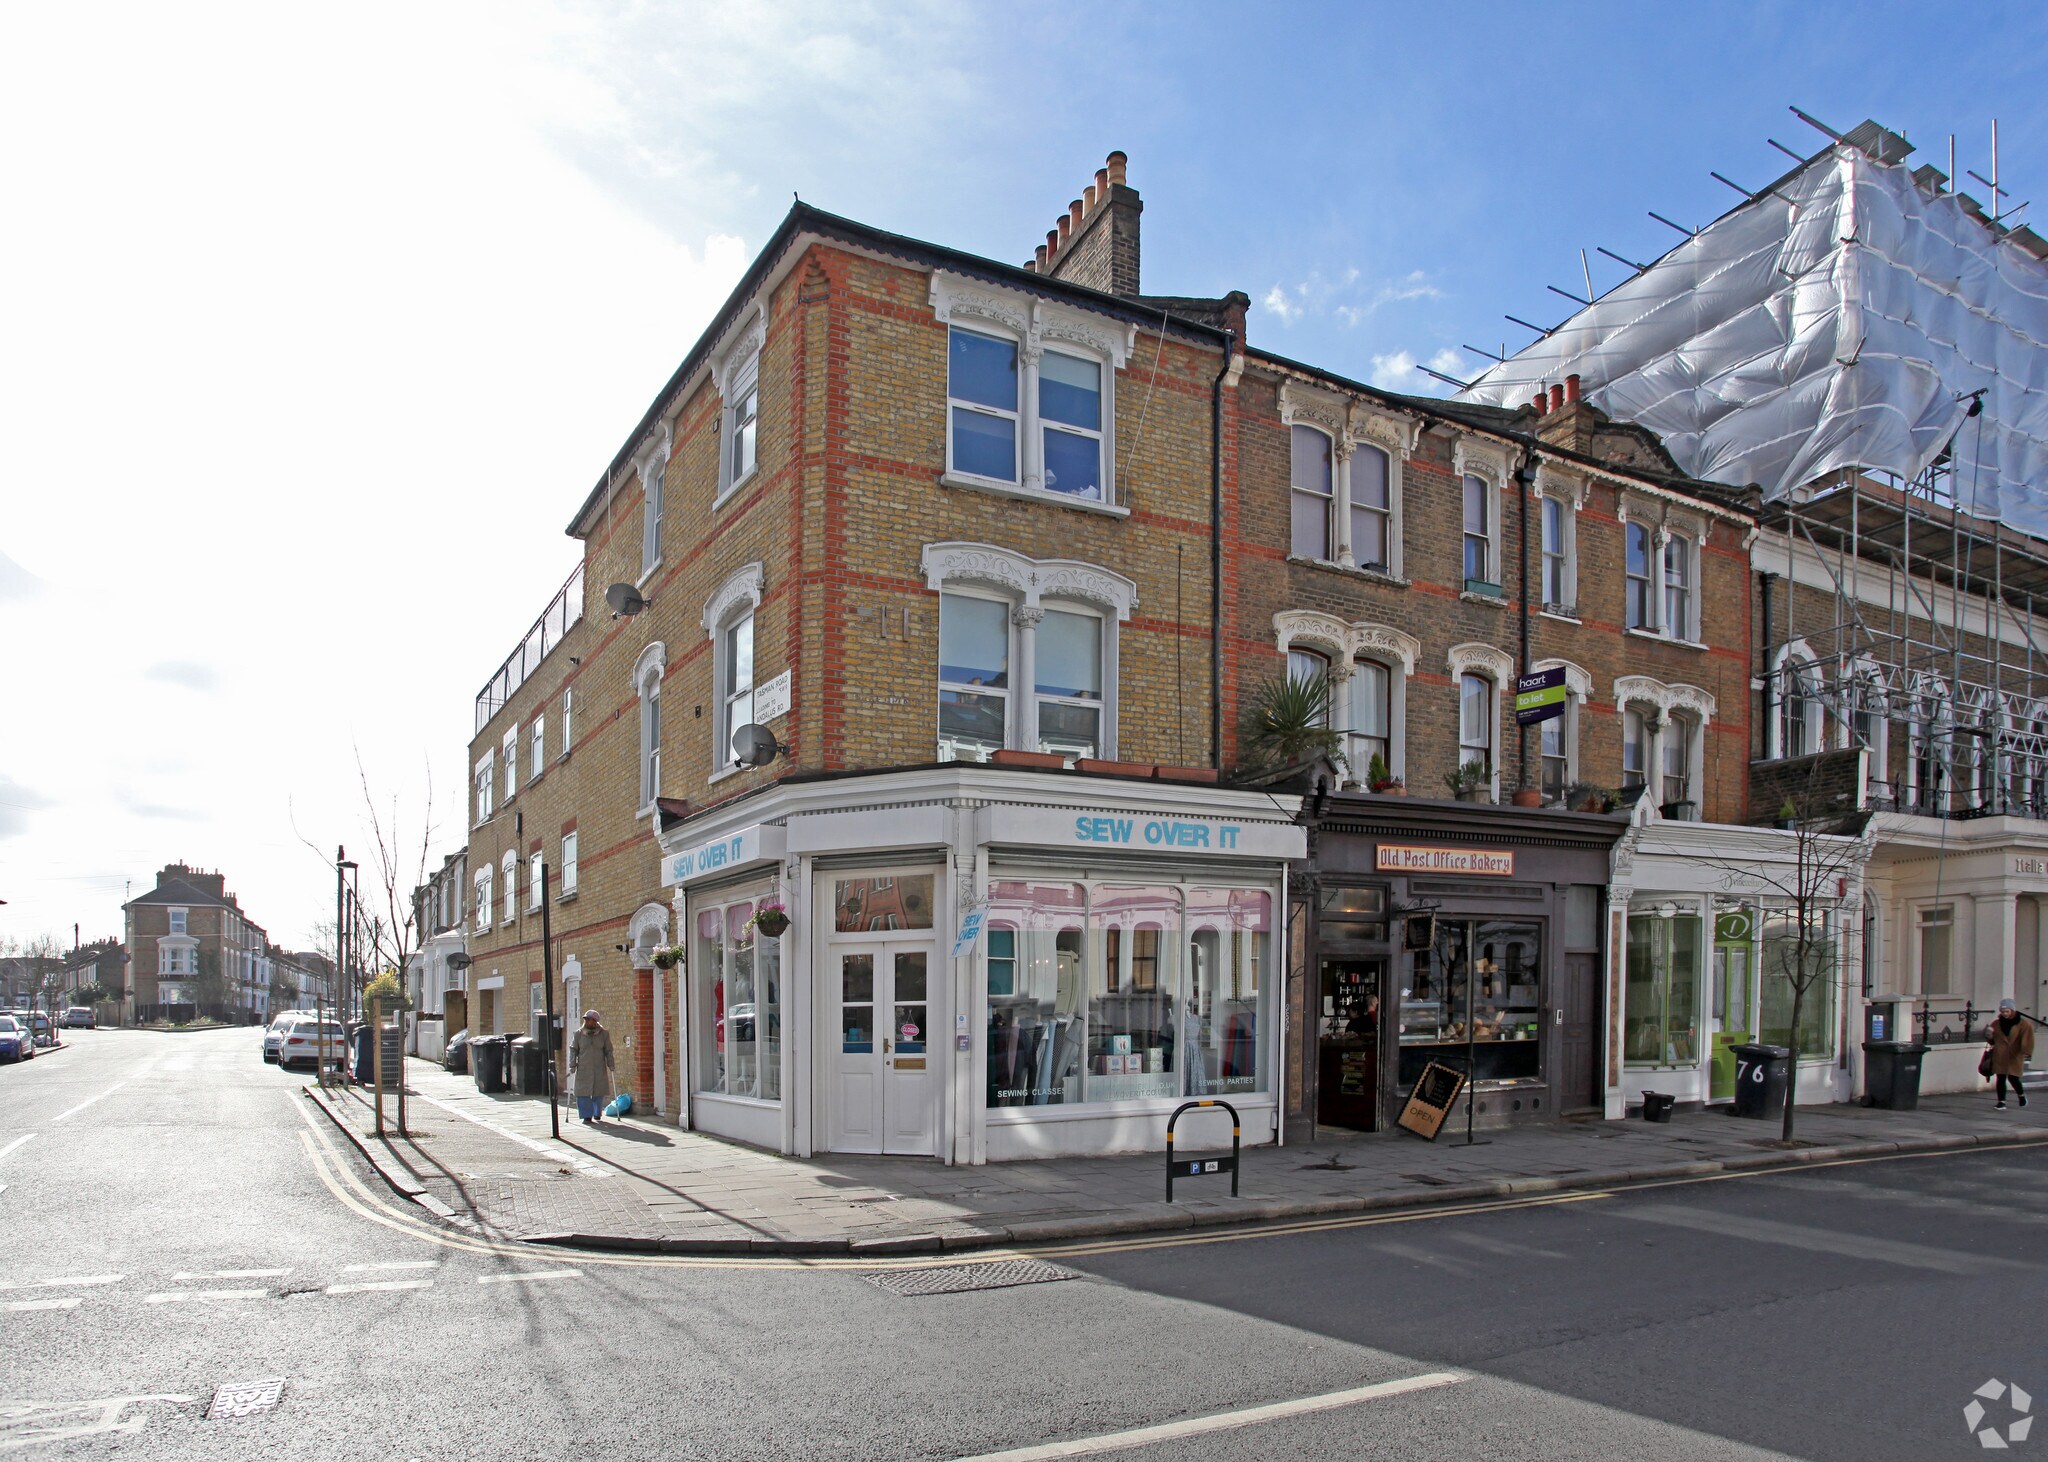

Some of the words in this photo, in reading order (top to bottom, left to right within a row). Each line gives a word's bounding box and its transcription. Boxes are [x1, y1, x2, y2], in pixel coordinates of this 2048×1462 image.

[1519, 675, 1546, 688] haart
[1519, 697, 1529, 705] to
[1532, 693, 1544, 703] let
[1075, 816, 1134, 843] SEW
[1144, 821, 1210, 848] OVER
[1219, 826, 1241, 849] IT
[672, 856, 695, 880] SEW
[698, 845, 728, 871] OVER
[731, 836, 743, 862] IT
[1380, 848, 1400, 866] Old
[1404, 849, 1430, 868] Post
[1433, 851, 1467, 869] Office
[1470, 853, 1510, 874] Bakery
[963, 913, 983, 927] SEW
[1718, 914, 1750, 939] D
[958, 927, 980, 942] OVER
[952, 942, 961, 956] IT
[1198, 1078, 1224, 1087] SEWING
[1227, 1076, 1254, 1086] PARTIES
[997, 1088, 1028, 1098] SEWING
[1031, 1087, 1065, 1096] CLASSES
[1409, 1106, 1436, 1124] OPEN
[1192, 1163, 1199, 1173] P
